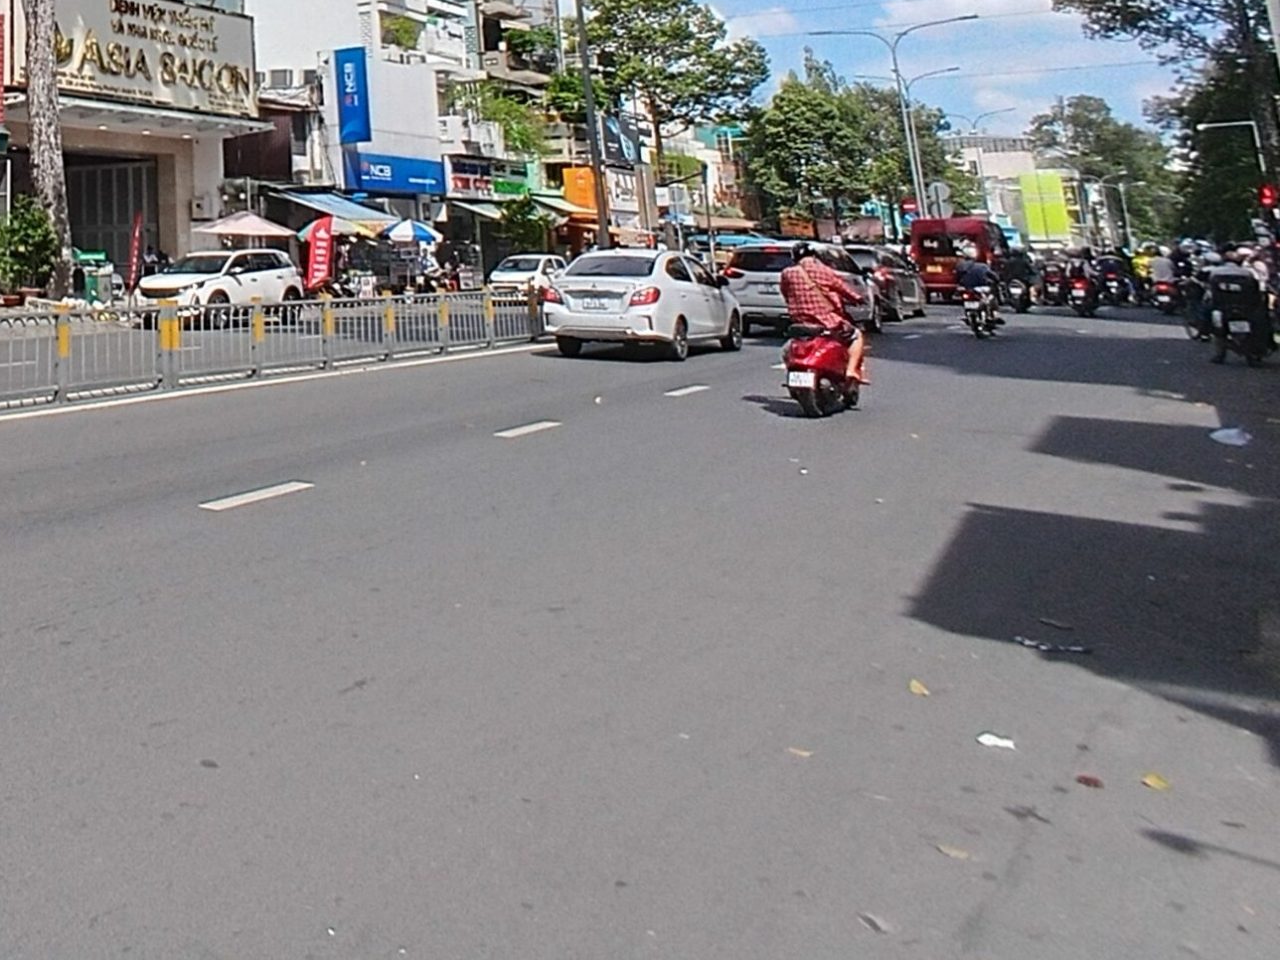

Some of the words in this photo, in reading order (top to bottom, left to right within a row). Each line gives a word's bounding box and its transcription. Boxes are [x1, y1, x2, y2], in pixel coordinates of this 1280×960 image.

[77, 28, 152, 83] ASIA
[343, 62, 357, 93] NCB
[370, 164, 392, 177] NCB
